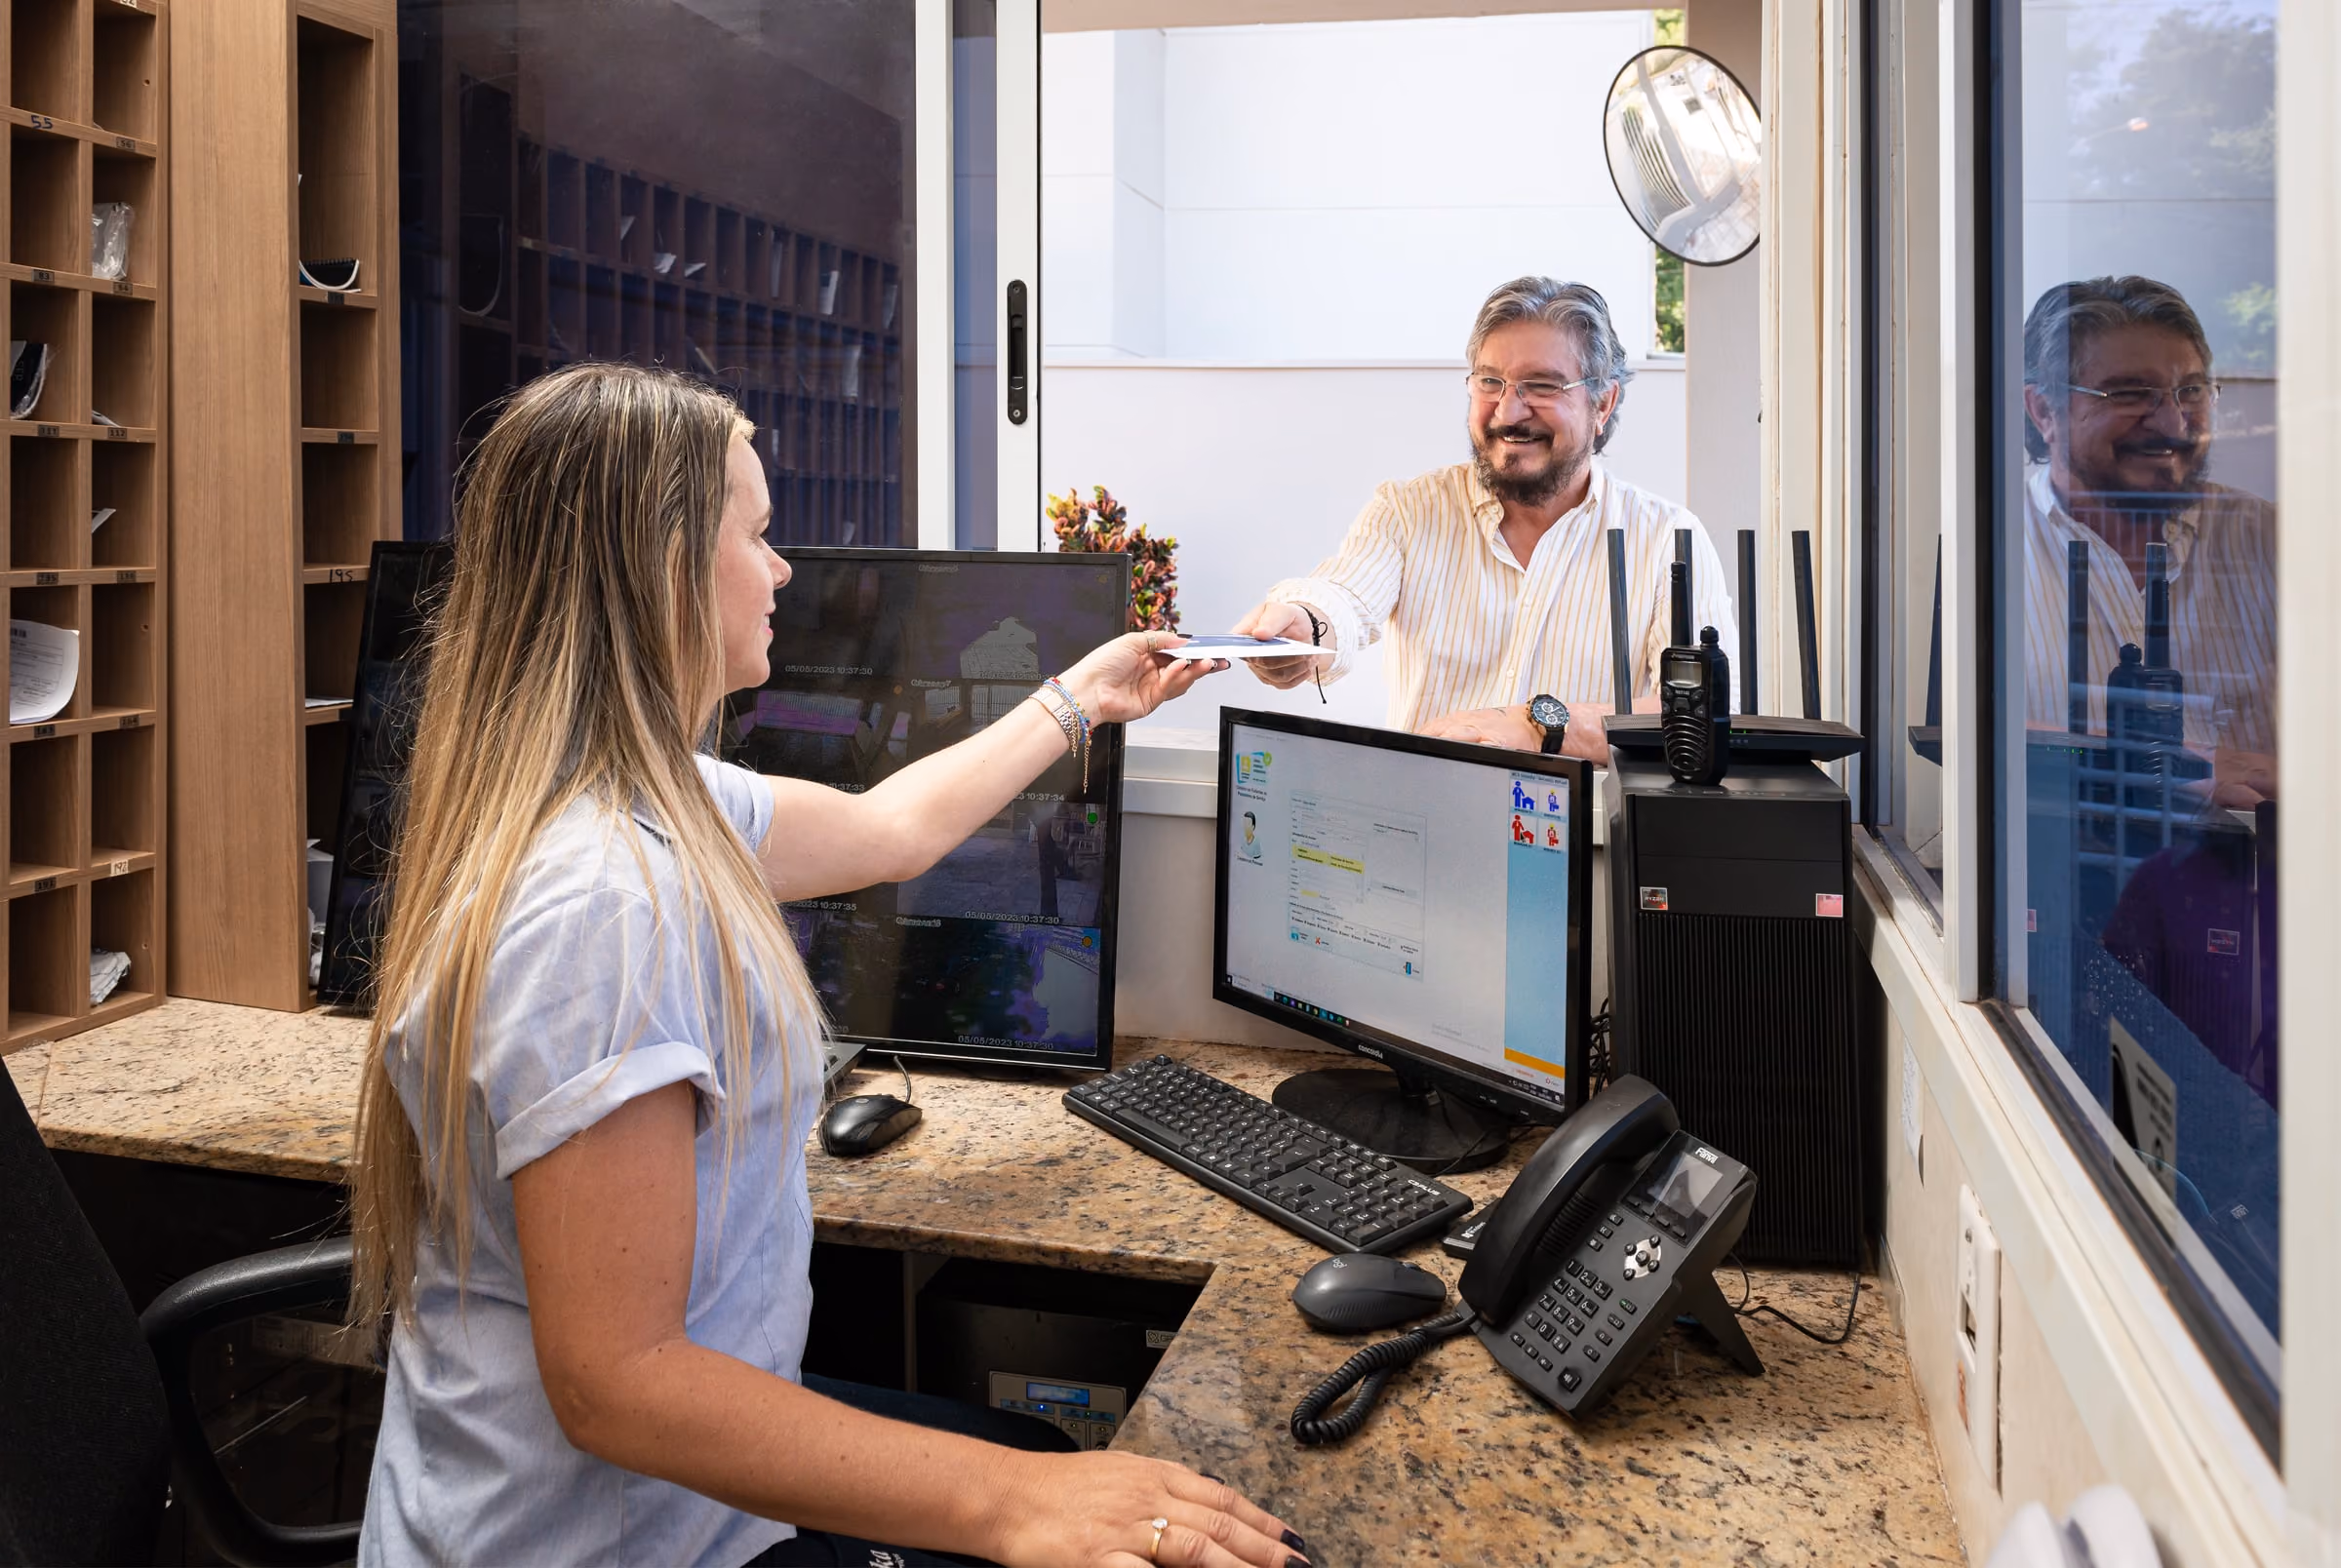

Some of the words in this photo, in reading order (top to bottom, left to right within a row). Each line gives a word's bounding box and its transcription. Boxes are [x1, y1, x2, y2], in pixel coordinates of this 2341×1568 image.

[30, 114, 54, 130] 55
[1027, 793, 1065, 802] 10:37:34
[965, 911, 1018, 921] 05/05/2023
[1020, 914, 1059, 924] 10:37:30
[958, 1035, 1012, 1046] 05/05/2023
[1013, 1039, 1054, 1050] 10:37:30
